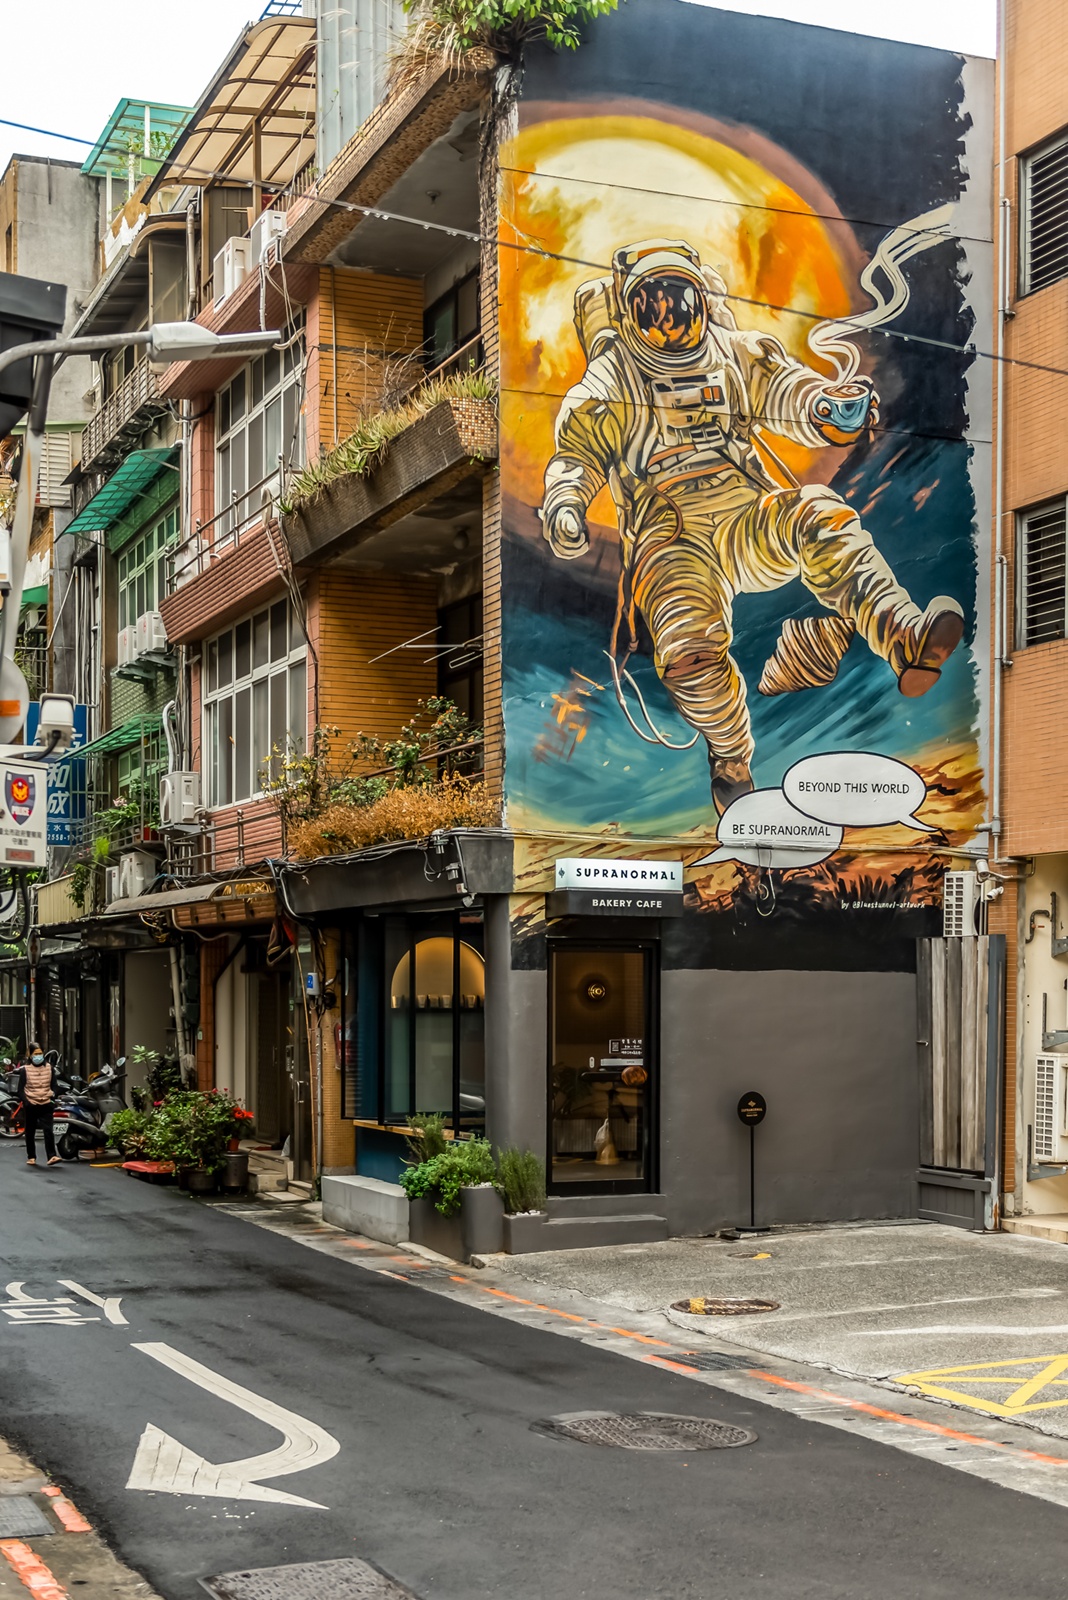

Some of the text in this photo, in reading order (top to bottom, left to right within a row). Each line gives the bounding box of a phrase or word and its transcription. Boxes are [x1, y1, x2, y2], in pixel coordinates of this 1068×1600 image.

[798, 781, 910, 795] BEYOND THIS WORLD
[732, 823, 831, 837] BE SUPRANORMAL
[575, 867, 676, 881] SUPRANORMAL
[592, 898, 663, 909] BAKERY CAFE
[841, 899, 850, 910] by
